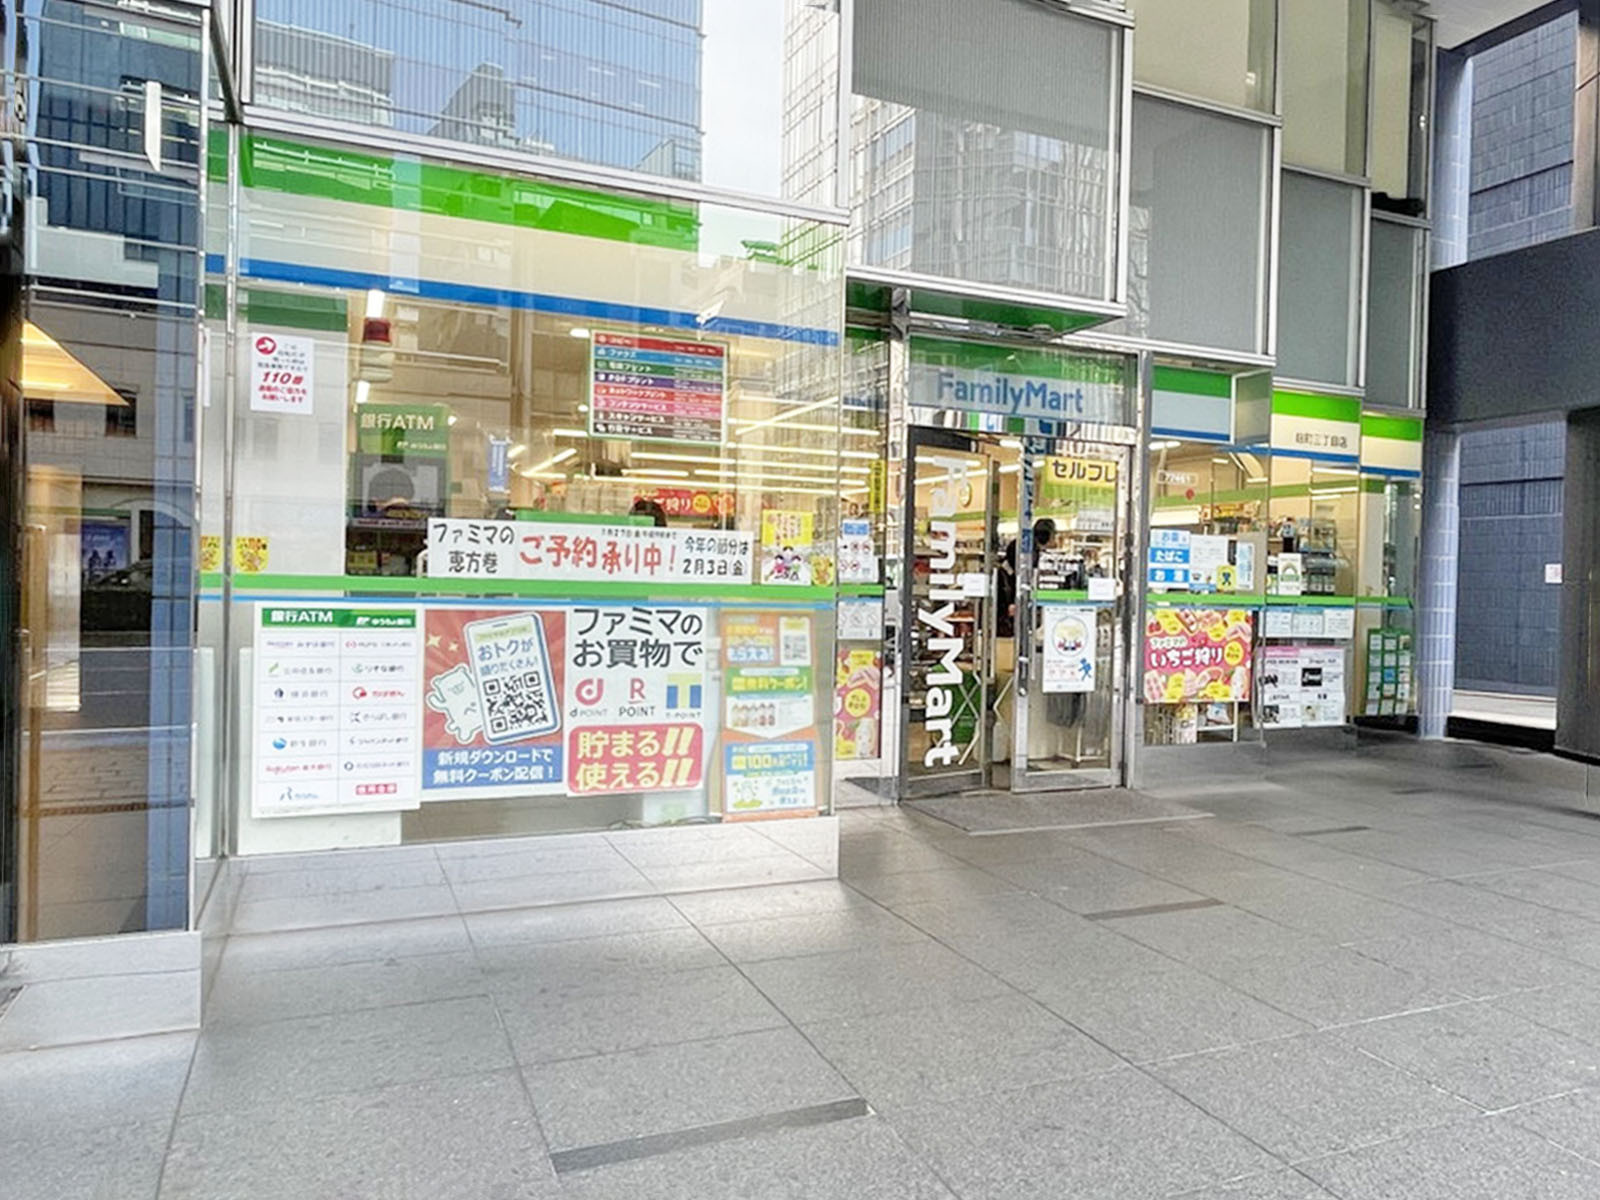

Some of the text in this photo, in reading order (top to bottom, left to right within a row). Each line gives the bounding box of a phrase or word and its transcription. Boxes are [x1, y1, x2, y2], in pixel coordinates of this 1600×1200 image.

[937, 371, 1084, 414] FamilyMart
[361, 413, 435, 430] 銀行ATM
[433, 523, 515, 545] ファミマの
[448, 550, 498, 574] 恵方巻
[519, 535, 676, 576] ご予約承り中!
[271, 610, 334, 623] 銀行ATM
[573, 607, 703, 636] ファミマの
[920, 455, 968, 768] FamilyMart
[478, 638, 534, 662] おトクが
[572, 639, 703, 669] お買物で
[1150, 646, 1223, 668] いちご狩り
[619, 706, 655, 716] POINT
[577, 728, 695, 759] 貯まる!!
[438, 749, 553, 766] 新規ダウンロードで
[433, 767, 553, 785] 無料クーポン配信!
[576, 759, 693, 790] 使える!!
